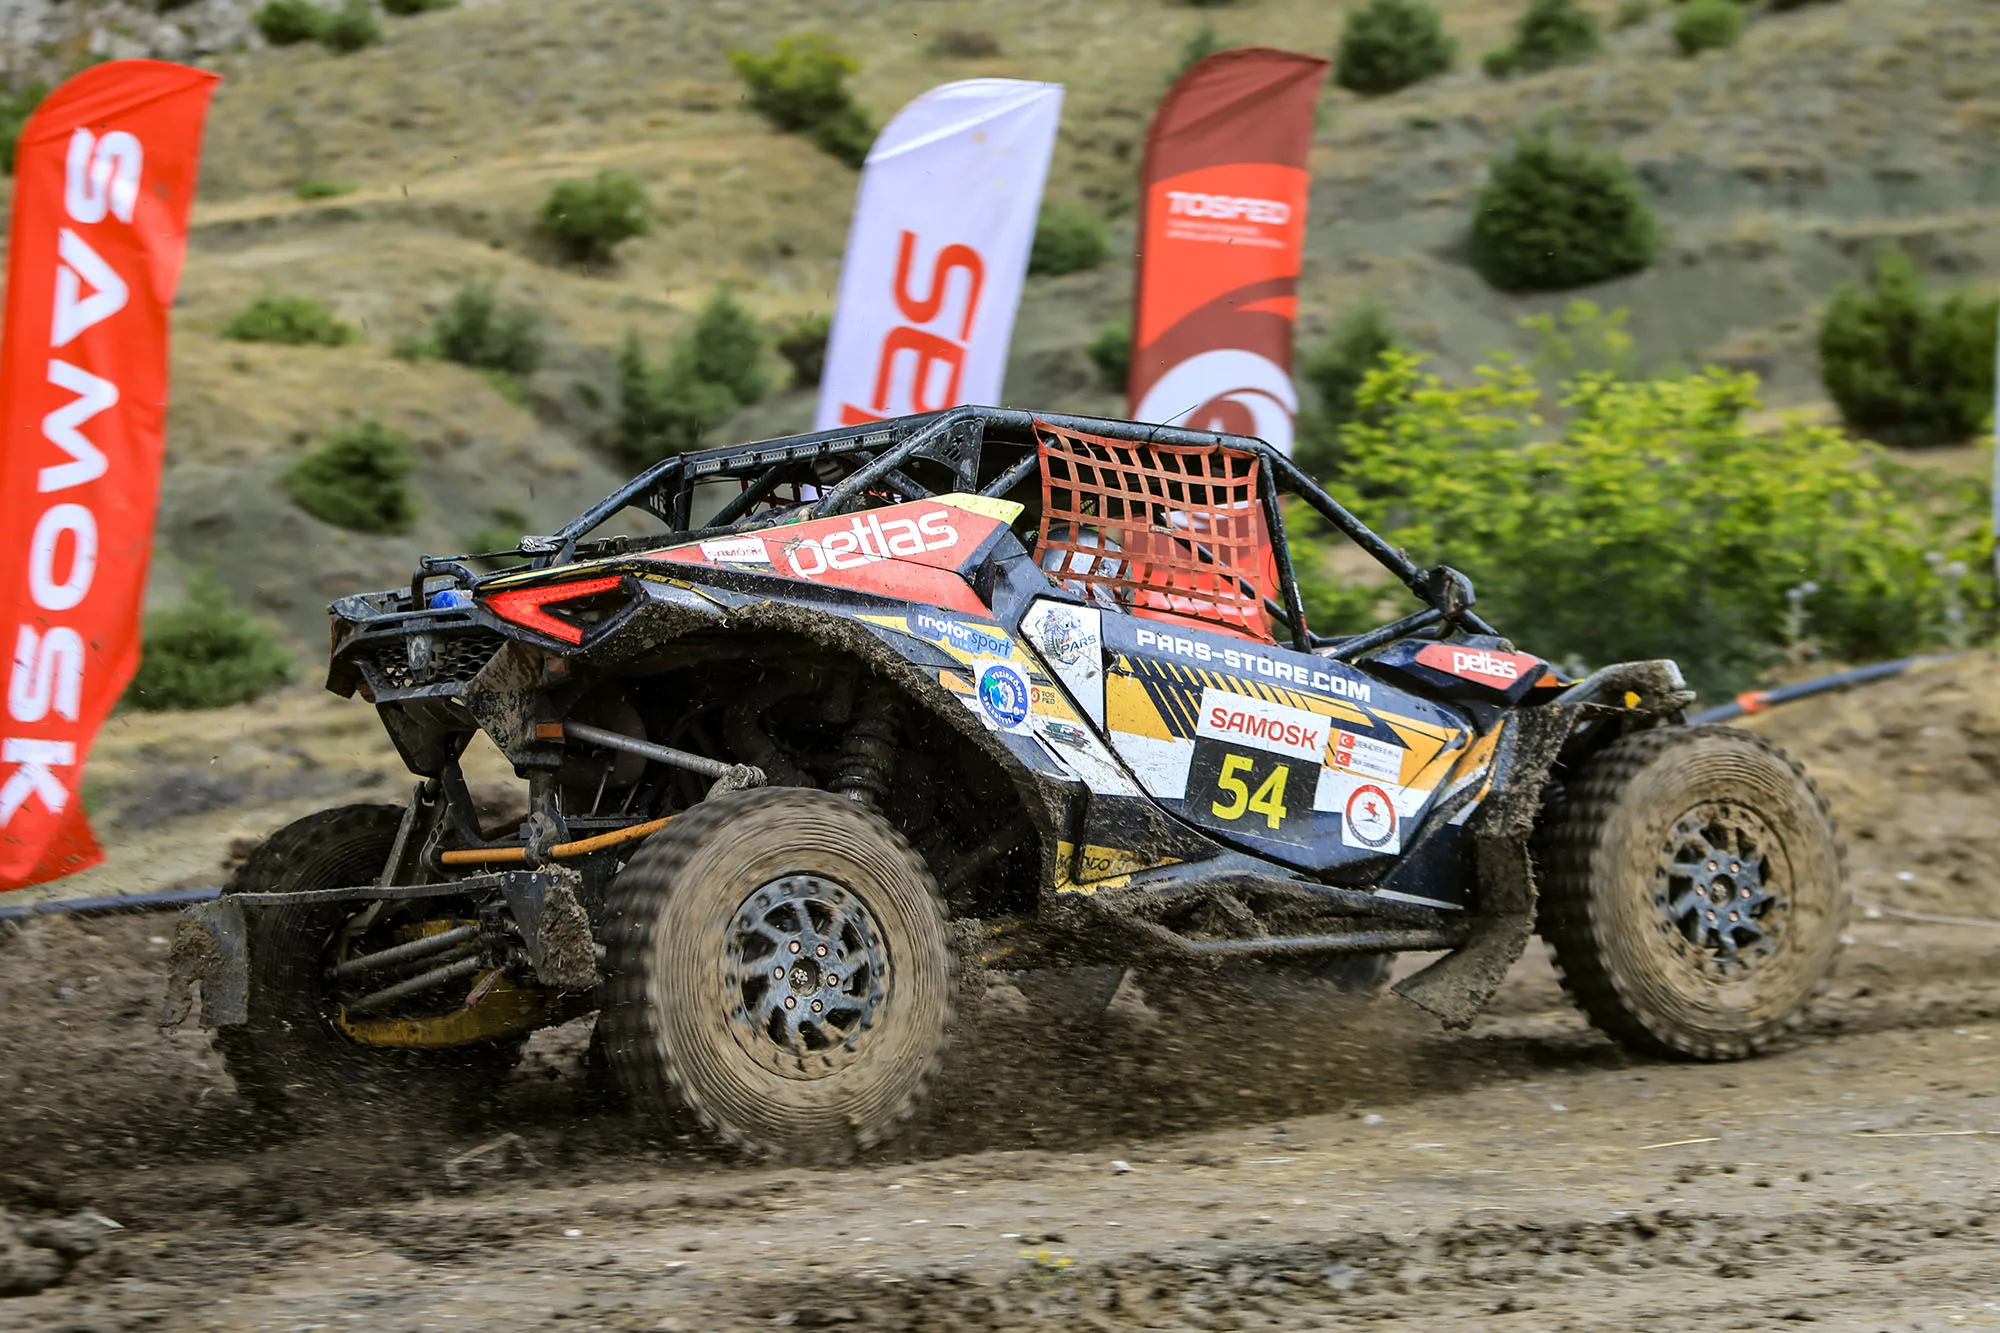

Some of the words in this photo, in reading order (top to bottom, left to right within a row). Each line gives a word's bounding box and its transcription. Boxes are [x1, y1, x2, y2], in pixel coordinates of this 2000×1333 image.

[1166, 191, 1291, 224] TOSFED
[0, 127, 144, 829] SAMOSK
[787, 509, 959, 579] petlas
[917, 613, 1011, 657] motorsport
[1061, 634, 1097, 652] PARS
[1137, 628, 1371, 703] PARS-STORE.COM
[1452, 650, 1518, 682] petlas
[1209, 706, 1319, 751] SAMOSK
[1211, 752, 1290, 830] 54
